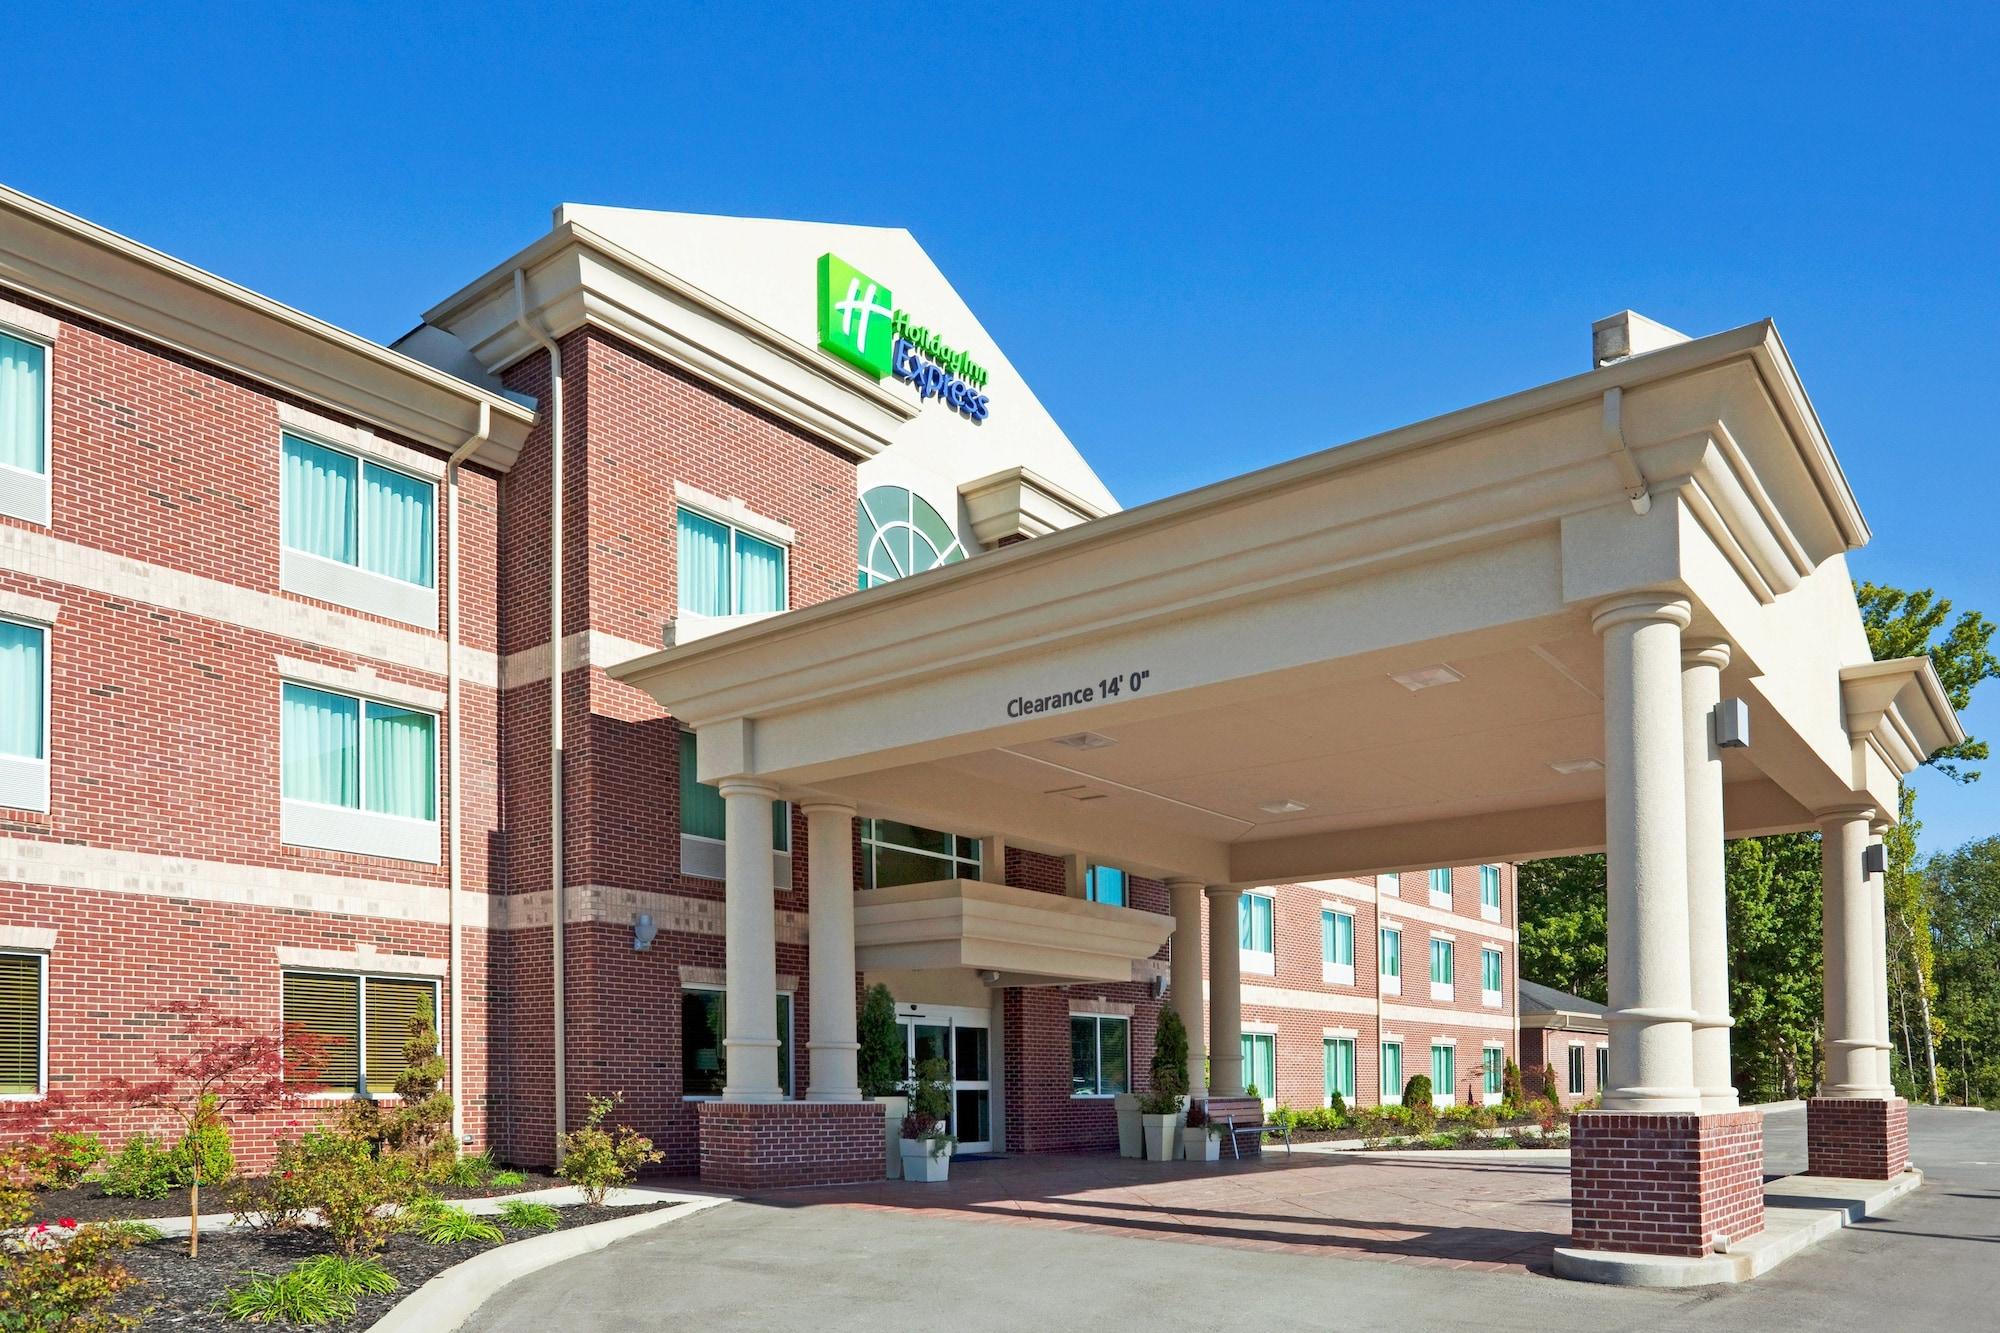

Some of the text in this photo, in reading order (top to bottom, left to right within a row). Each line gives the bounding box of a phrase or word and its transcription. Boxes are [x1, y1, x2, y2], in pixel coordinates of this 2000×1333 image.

[834, 277, 892, 354] H
[892, 309, 989, 386] Holiday Inn
[893, 337, 990, 420] Express
[1007, 687, 1094, 718] Clearance
[1099, 674, 1123, 699] 14'
